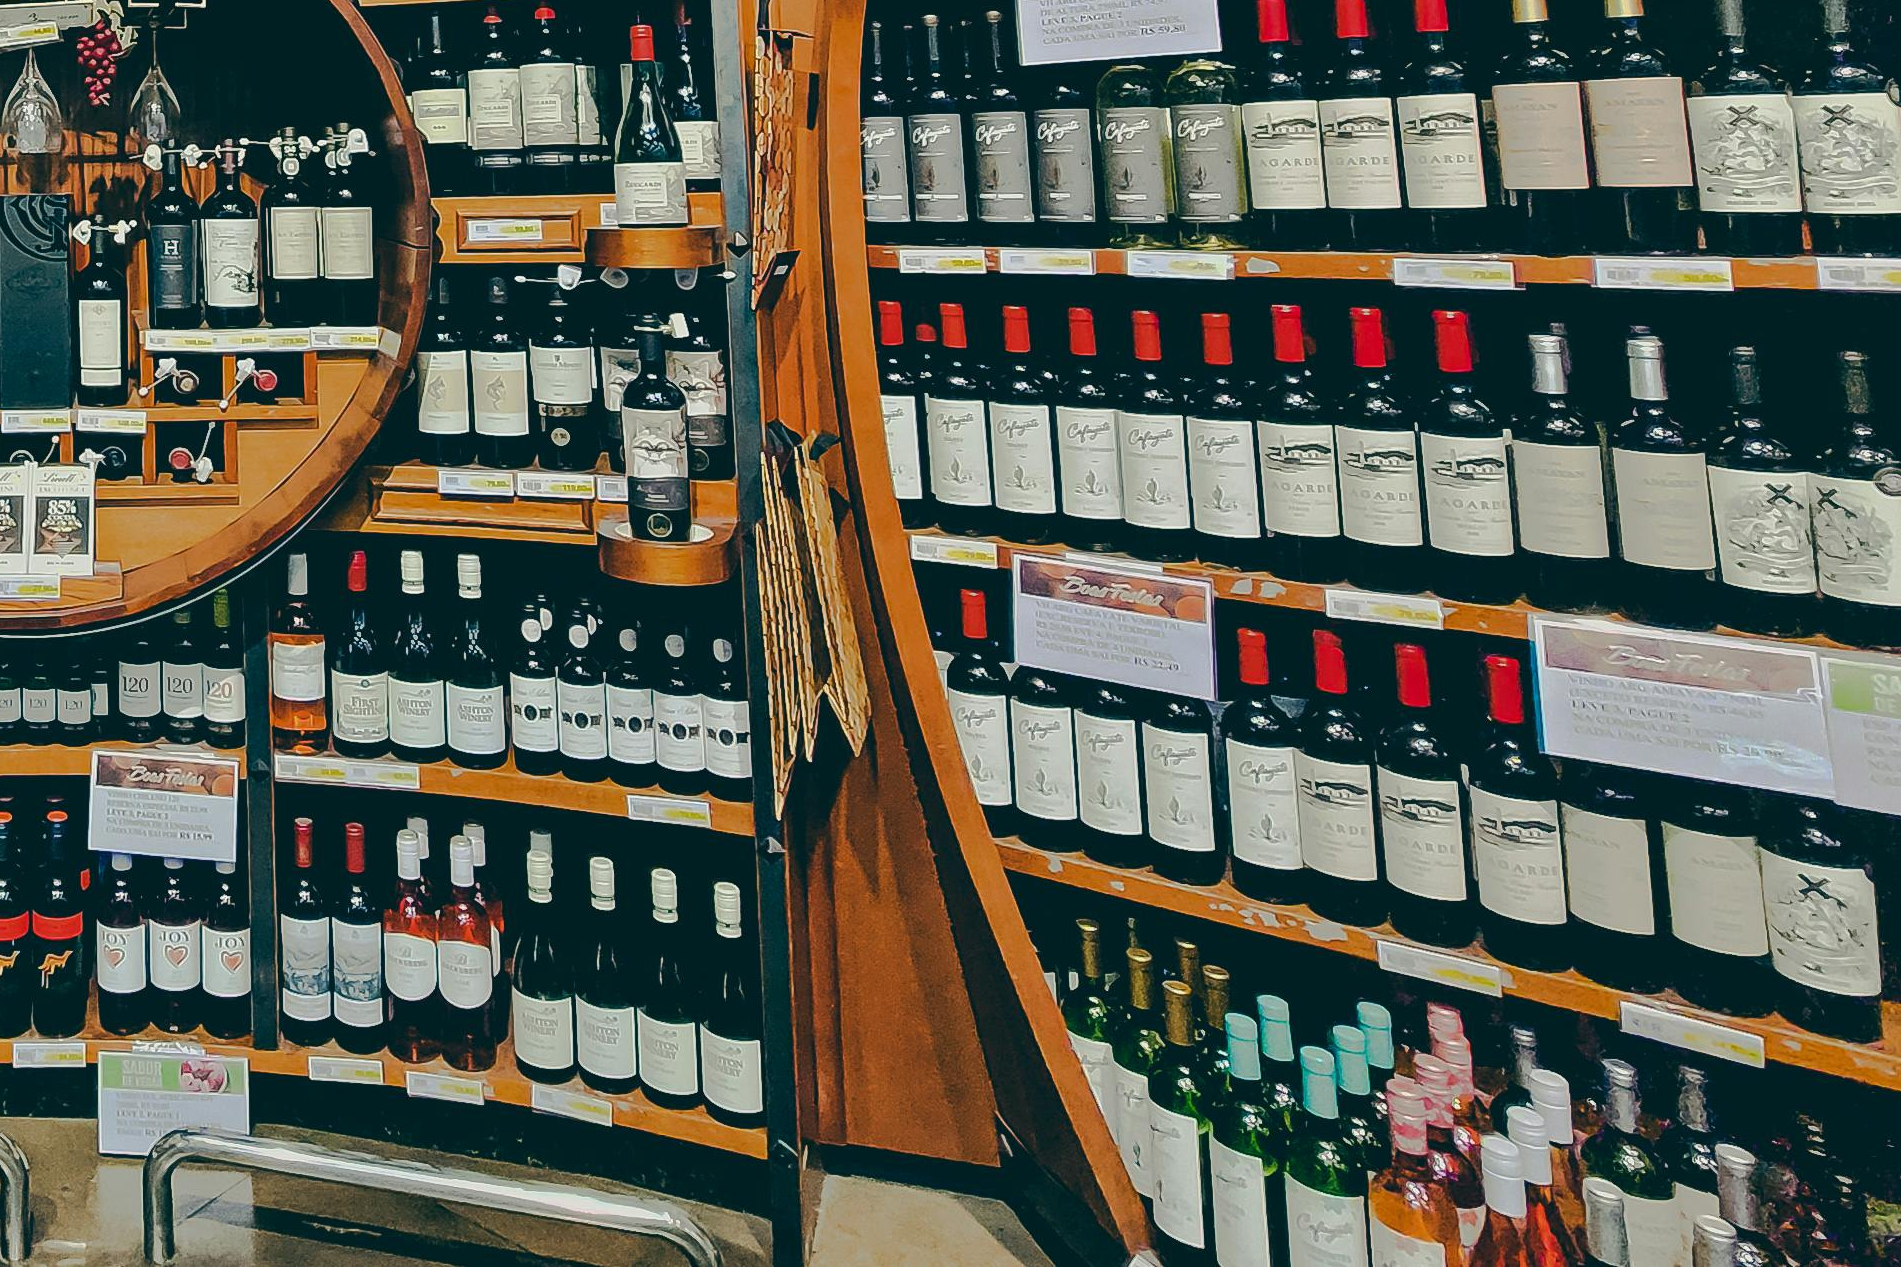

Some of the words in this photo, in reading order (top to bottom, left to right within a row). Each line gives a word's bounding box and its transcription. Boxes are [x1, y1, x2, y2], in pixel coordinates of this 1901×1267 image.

[164, 240, 179, 255] H
[48, 500, 76, 514] 85%
[122, 676, 149, 693] 120
[166, 677, 193, 694] 120
[206, 679, 232, 698] 120
[29, 697, 48, 709] 120
[64, 699, 83, 710] 120
[160, 930, 189, 943] JOY
[122, 1059, 162, 1075] SABOR
